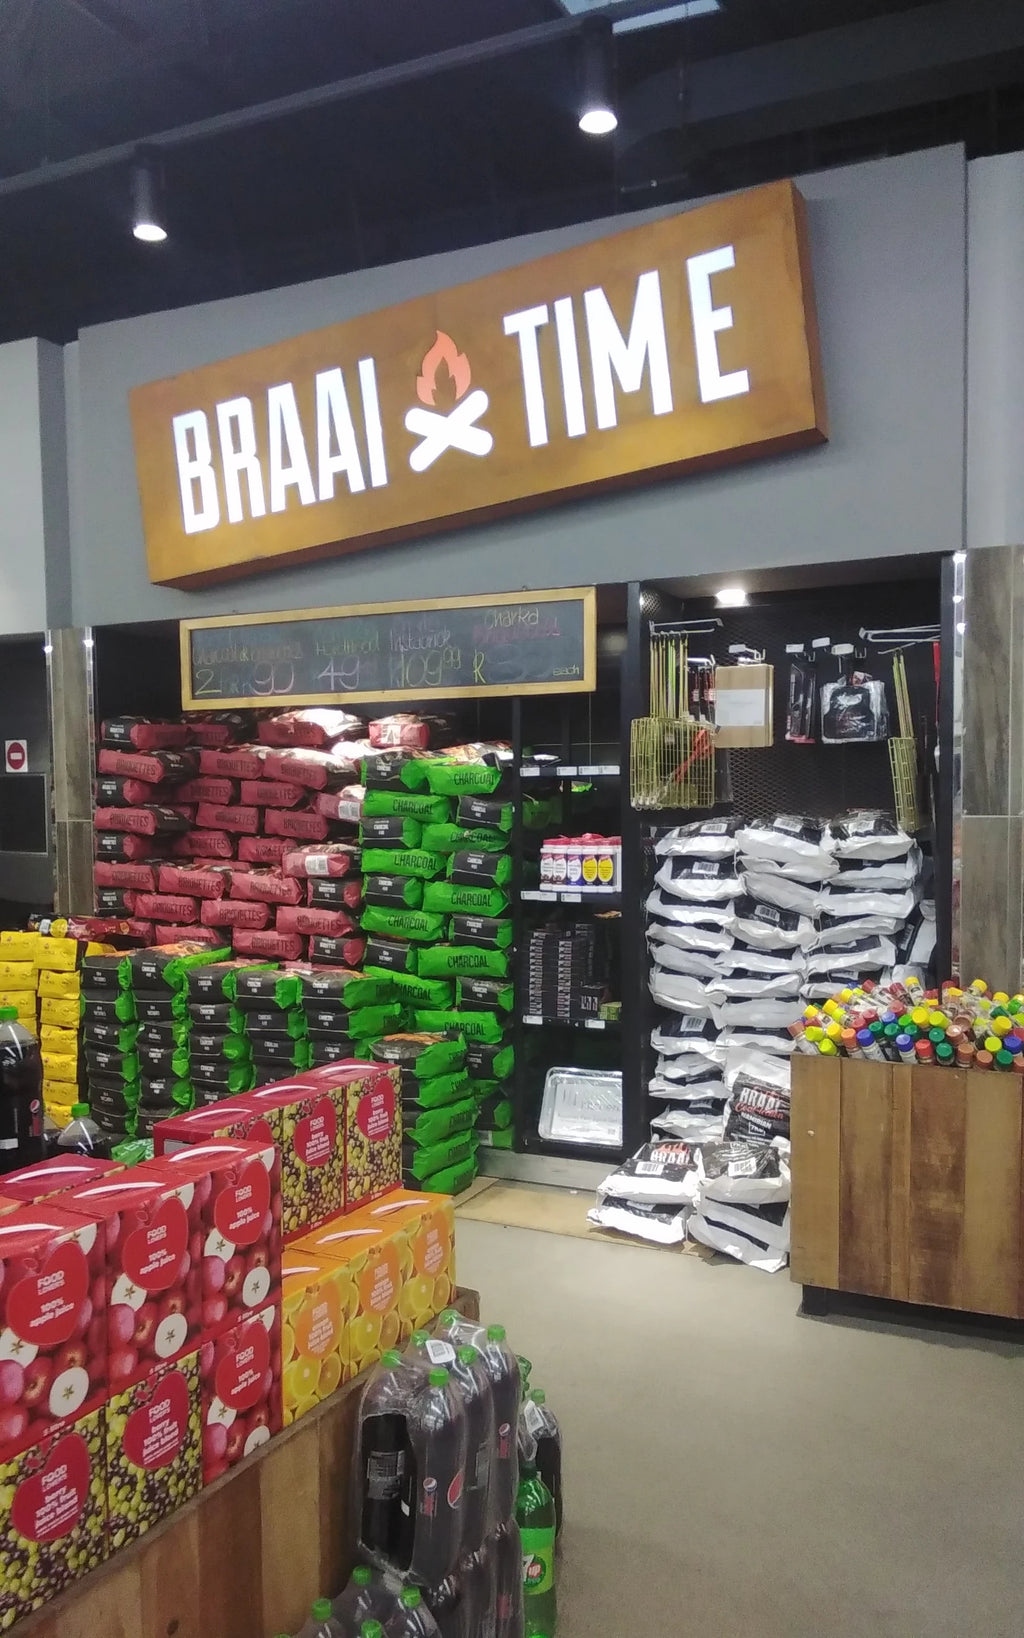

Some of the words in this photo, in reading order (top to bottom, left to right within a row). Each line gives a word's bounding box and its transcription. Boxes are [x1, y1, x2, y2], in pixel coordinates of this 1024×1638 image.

[172, 356, 389, 535] BRAAI
[503, 245, 750, 447] TIME
[394, 854, 438, 871] CHARCOAL
[451, 891, 492, 908] CHARCOAL
[387, 914, 429, 932] CHARCOAL
[447, 955, 490, 969] CHARCOAL
[398, 983, 432, 1001] HARCOAL
[235, 1184, 252, 1197] FOOD
[147, 1225, 167, 1238] FOOD
[37, 1270, 65, 1288] FOOD
[235, 1345, 254, 1362] FOOD
[148, 1399, 171, 1416] FOOD
[41, 1464, 68, 1486] FOOD
